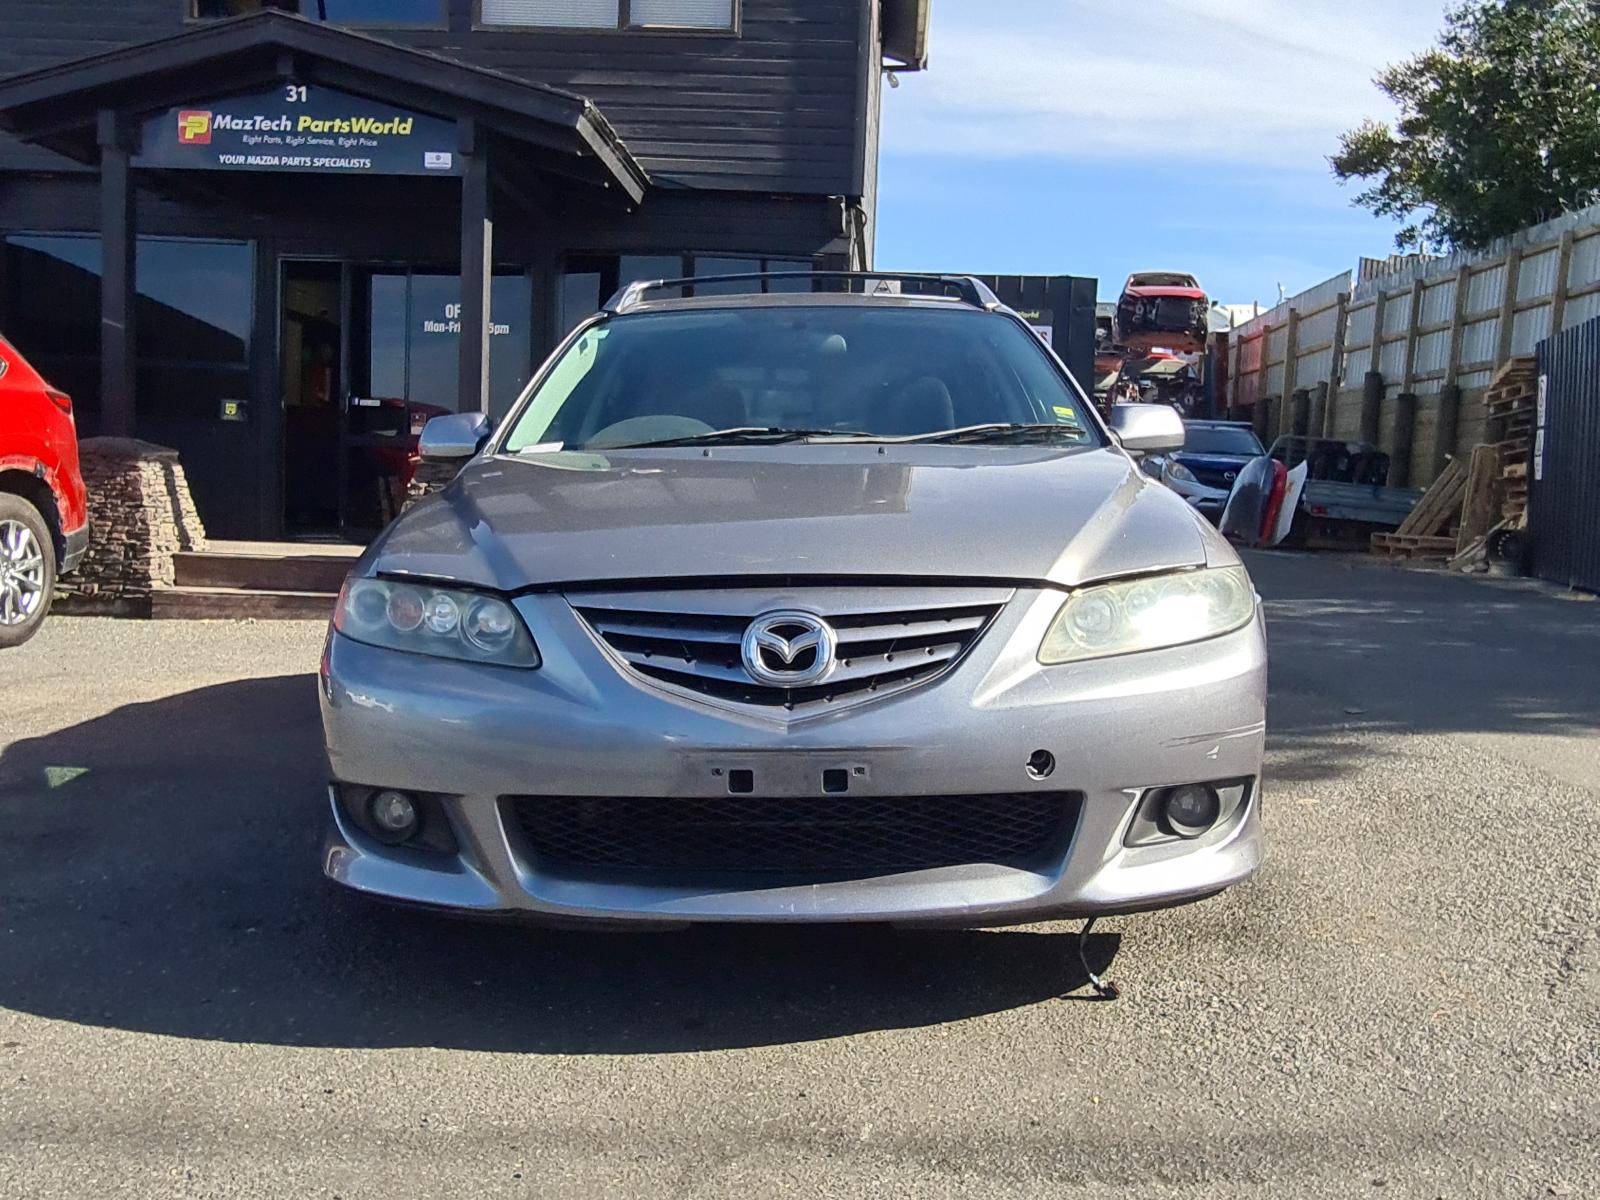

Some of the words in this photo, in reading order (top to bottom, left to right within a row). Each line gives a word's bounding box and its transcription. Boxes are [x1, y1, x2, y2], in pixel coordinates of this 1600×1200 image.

[286, 85, 307, 102] 31
[213, 115, 292, 131] MazTech
[298, 116, 413, 135] PartsWorld
[242, 135, 262, 145] Right
[285, 136, 306, 147] Right
[338, 138, 358, 148] Right
[359, 138, 378, 147] Price
[219, 155, 245, 165] YOUR
[246, 156, 280, 166] MAZDA
[281, 157, 311, 167] PARTS
[313, 158, 371, 169] SPECIALISTS
